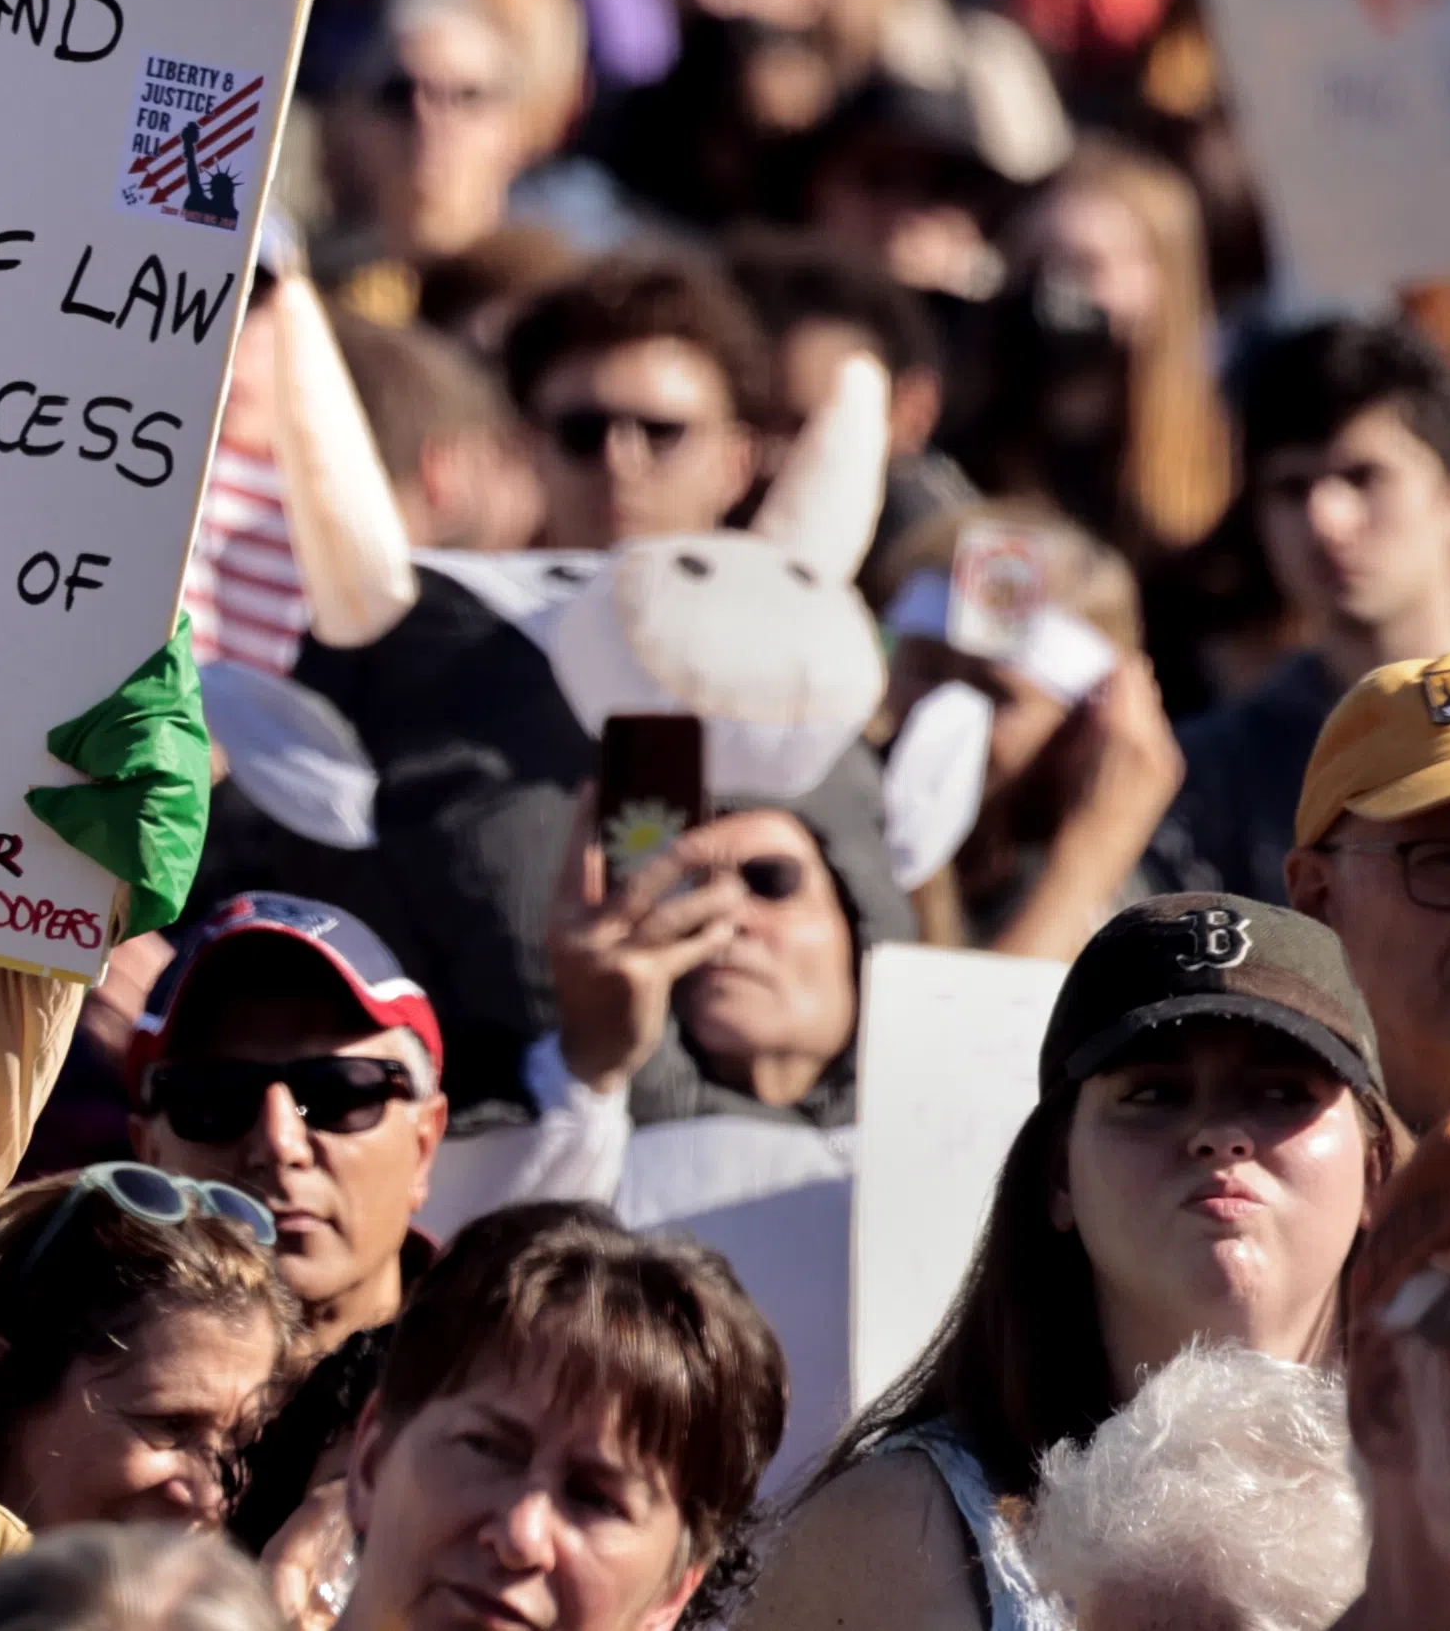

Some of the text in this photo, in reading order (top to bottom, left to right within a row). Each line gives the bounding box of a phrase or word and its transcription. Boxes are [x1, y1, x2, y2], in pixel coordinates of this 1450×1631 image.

[146, 56, 234, 93] LIBERTY &
[141, 82, 216, 115] JUSTICE
[136, 107, 171, 133] FOR
[132, 133, 161, 157] ALL
[61, 245, 235, 344] LAW
[17, 551, 111, 611] OF
[1172, 907, 1252, 971] B
